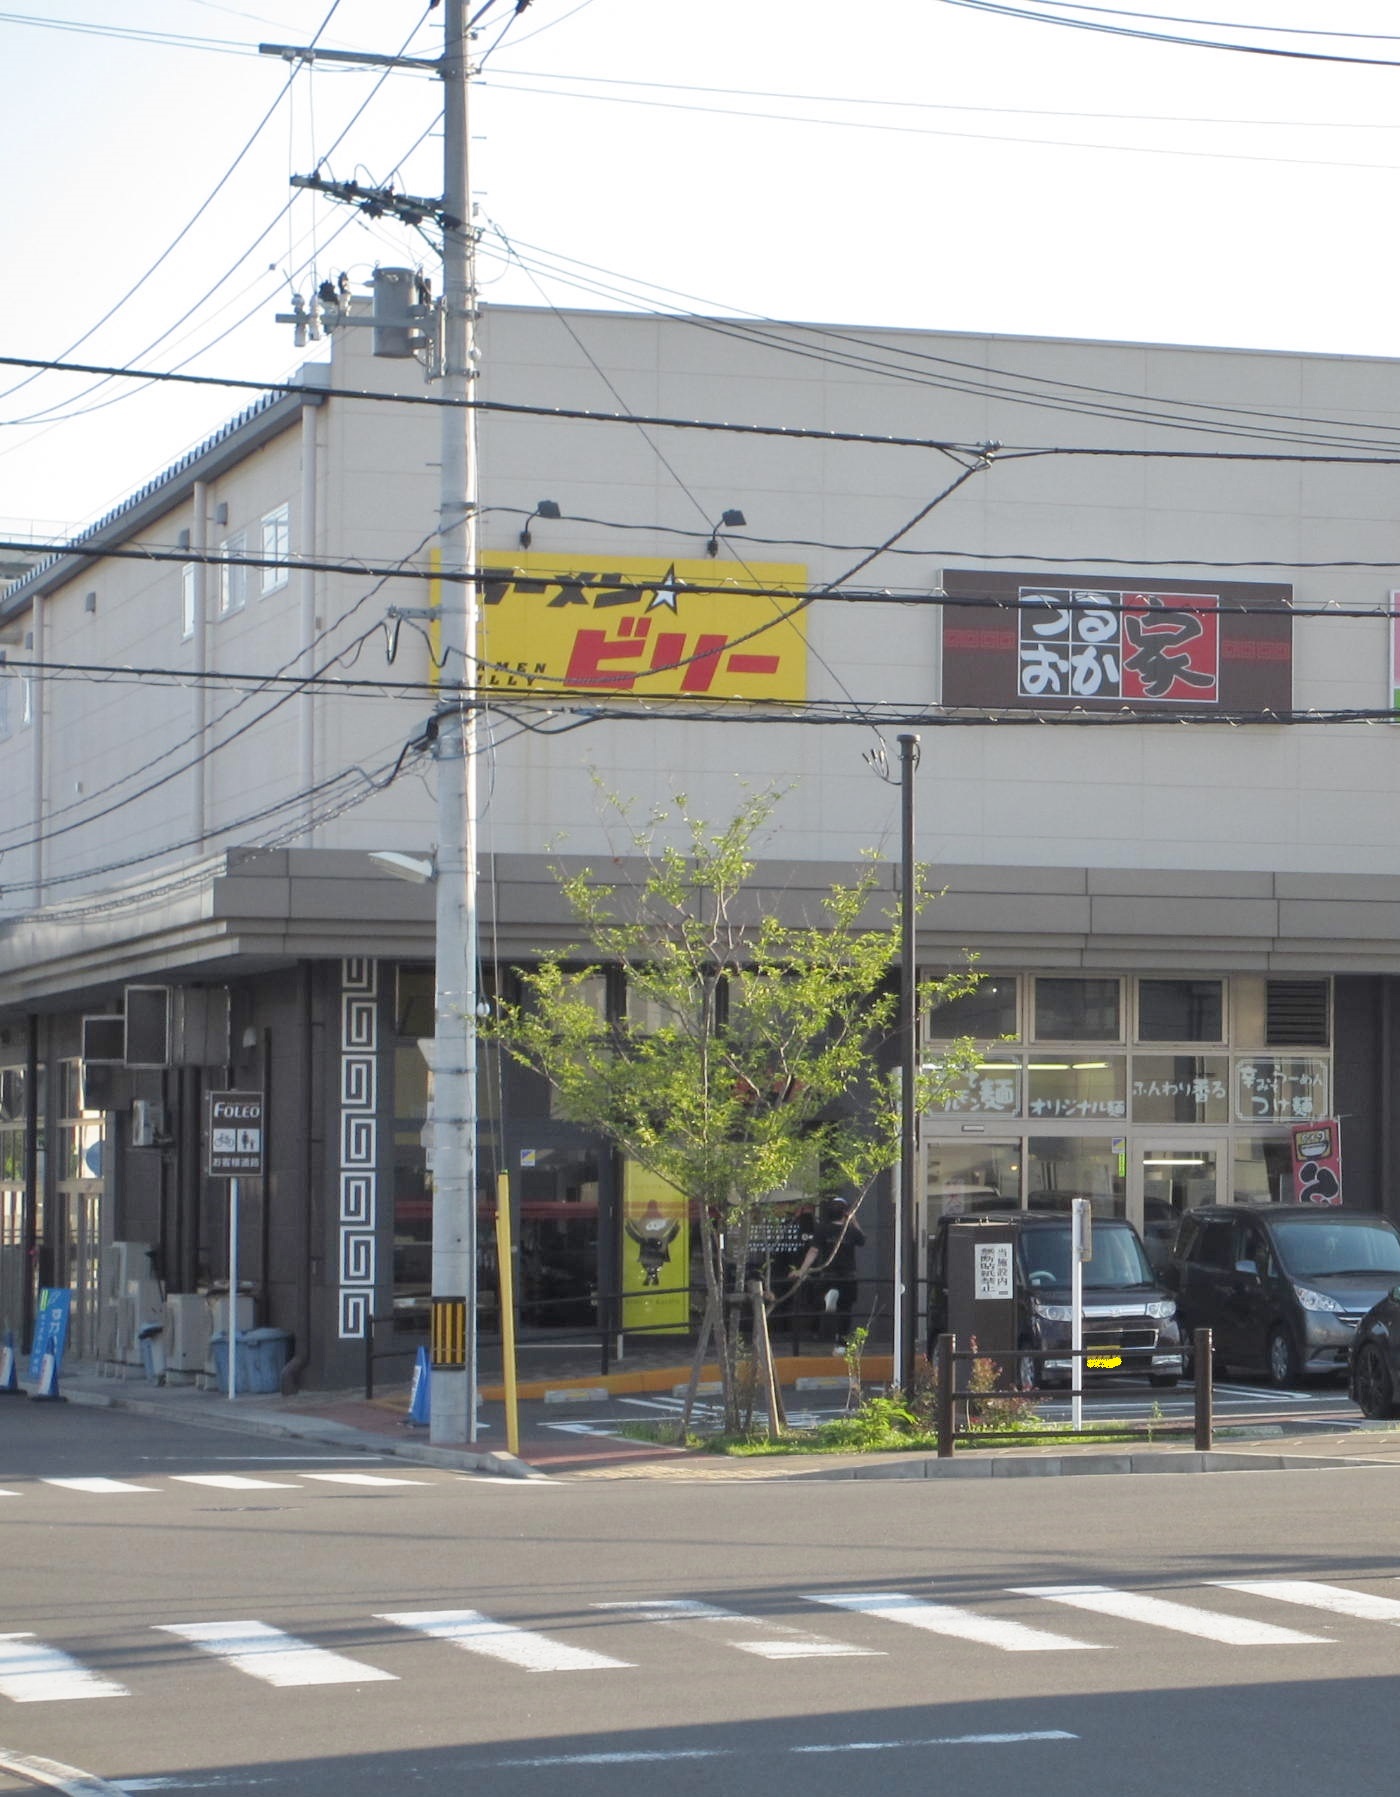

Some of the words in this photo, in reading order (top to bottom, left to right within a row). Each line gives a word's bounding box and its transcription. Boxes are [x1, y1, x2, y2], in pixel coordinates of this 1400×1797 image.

[562, 617, 779, 691] ビリー
[476, 661, 547, 674] AMEN
[477, 675, 536, 687] ILLY
[214, 1102, 260, 1118] FOLEO
